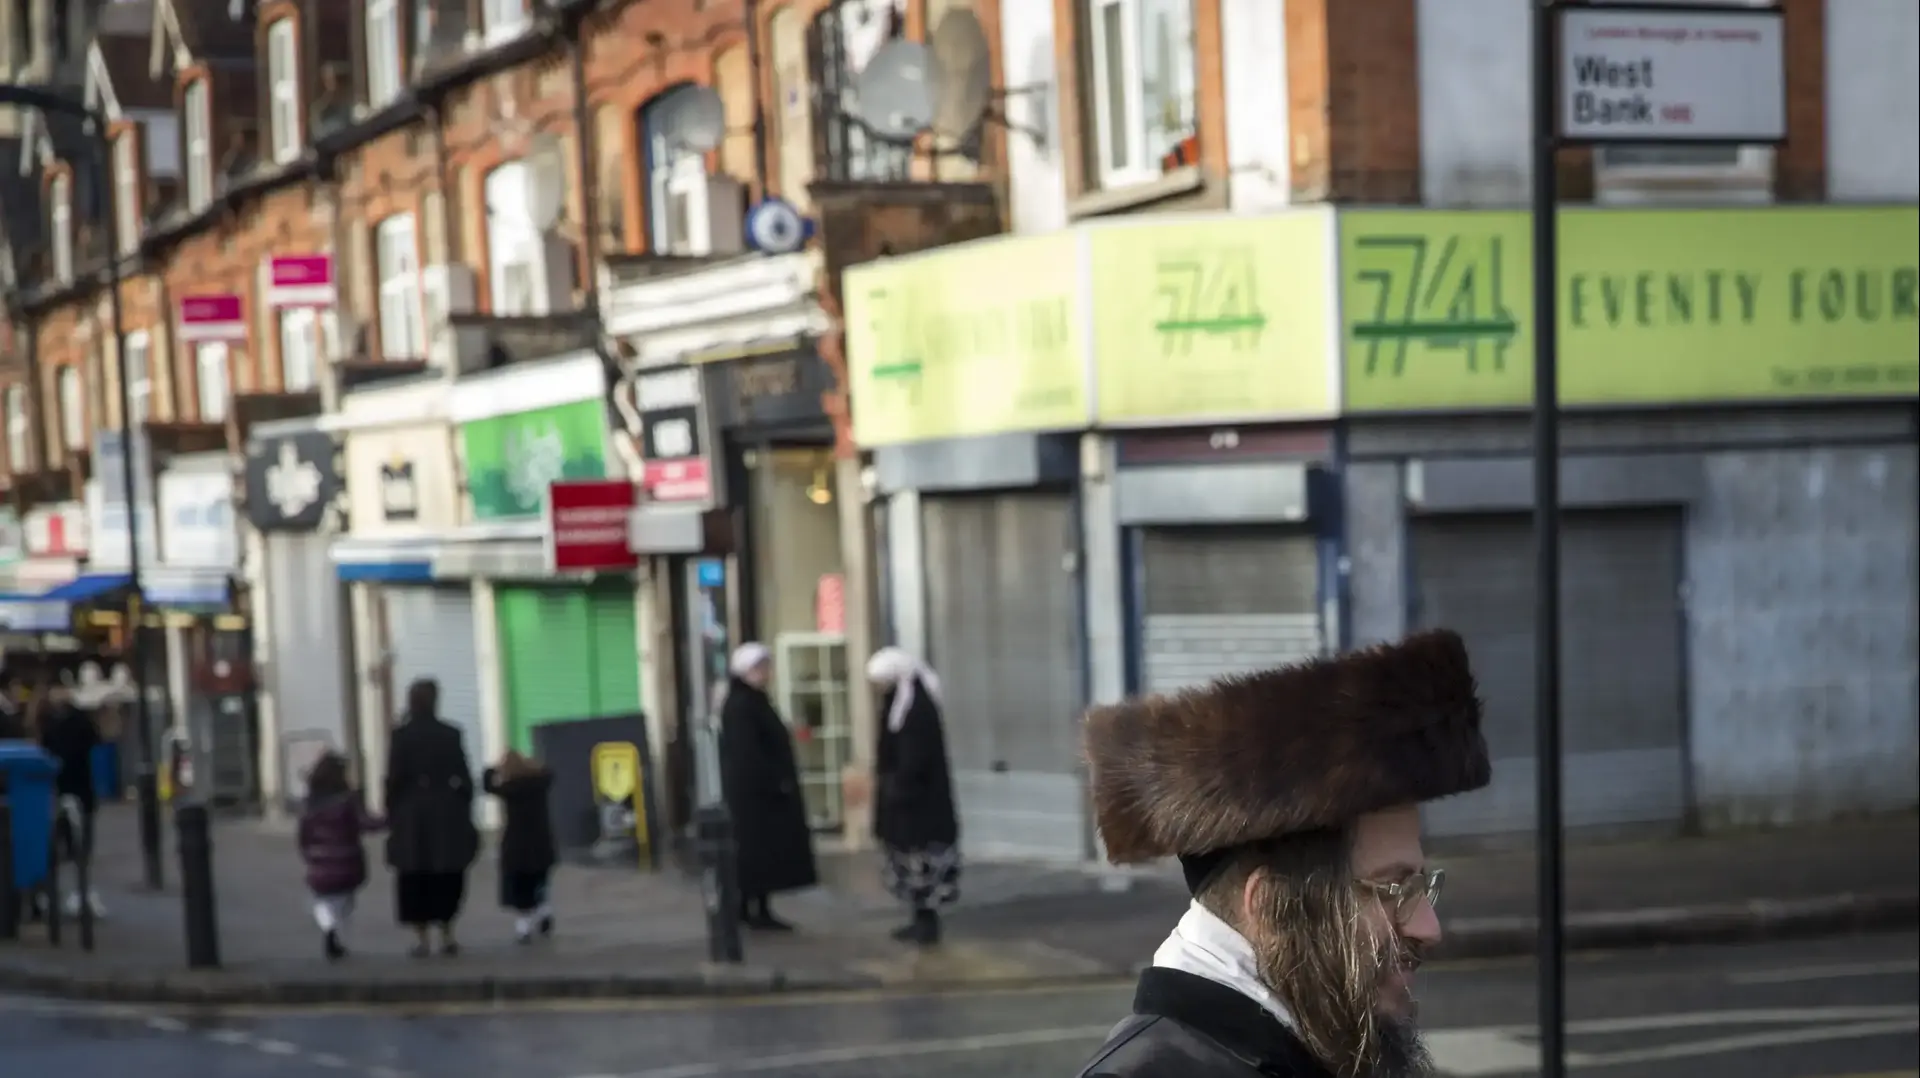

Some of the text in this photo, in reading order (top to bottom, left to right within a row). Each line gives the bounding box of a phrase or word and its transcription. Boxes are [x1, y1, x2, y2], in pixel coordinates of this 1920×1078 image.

[1574, 56, 1653, 88] West
[1573, 91, 1653, 124] Bank
[1353, 234, 1518, 376] 74
[1570, 269, 1762, 329] EVENTY
